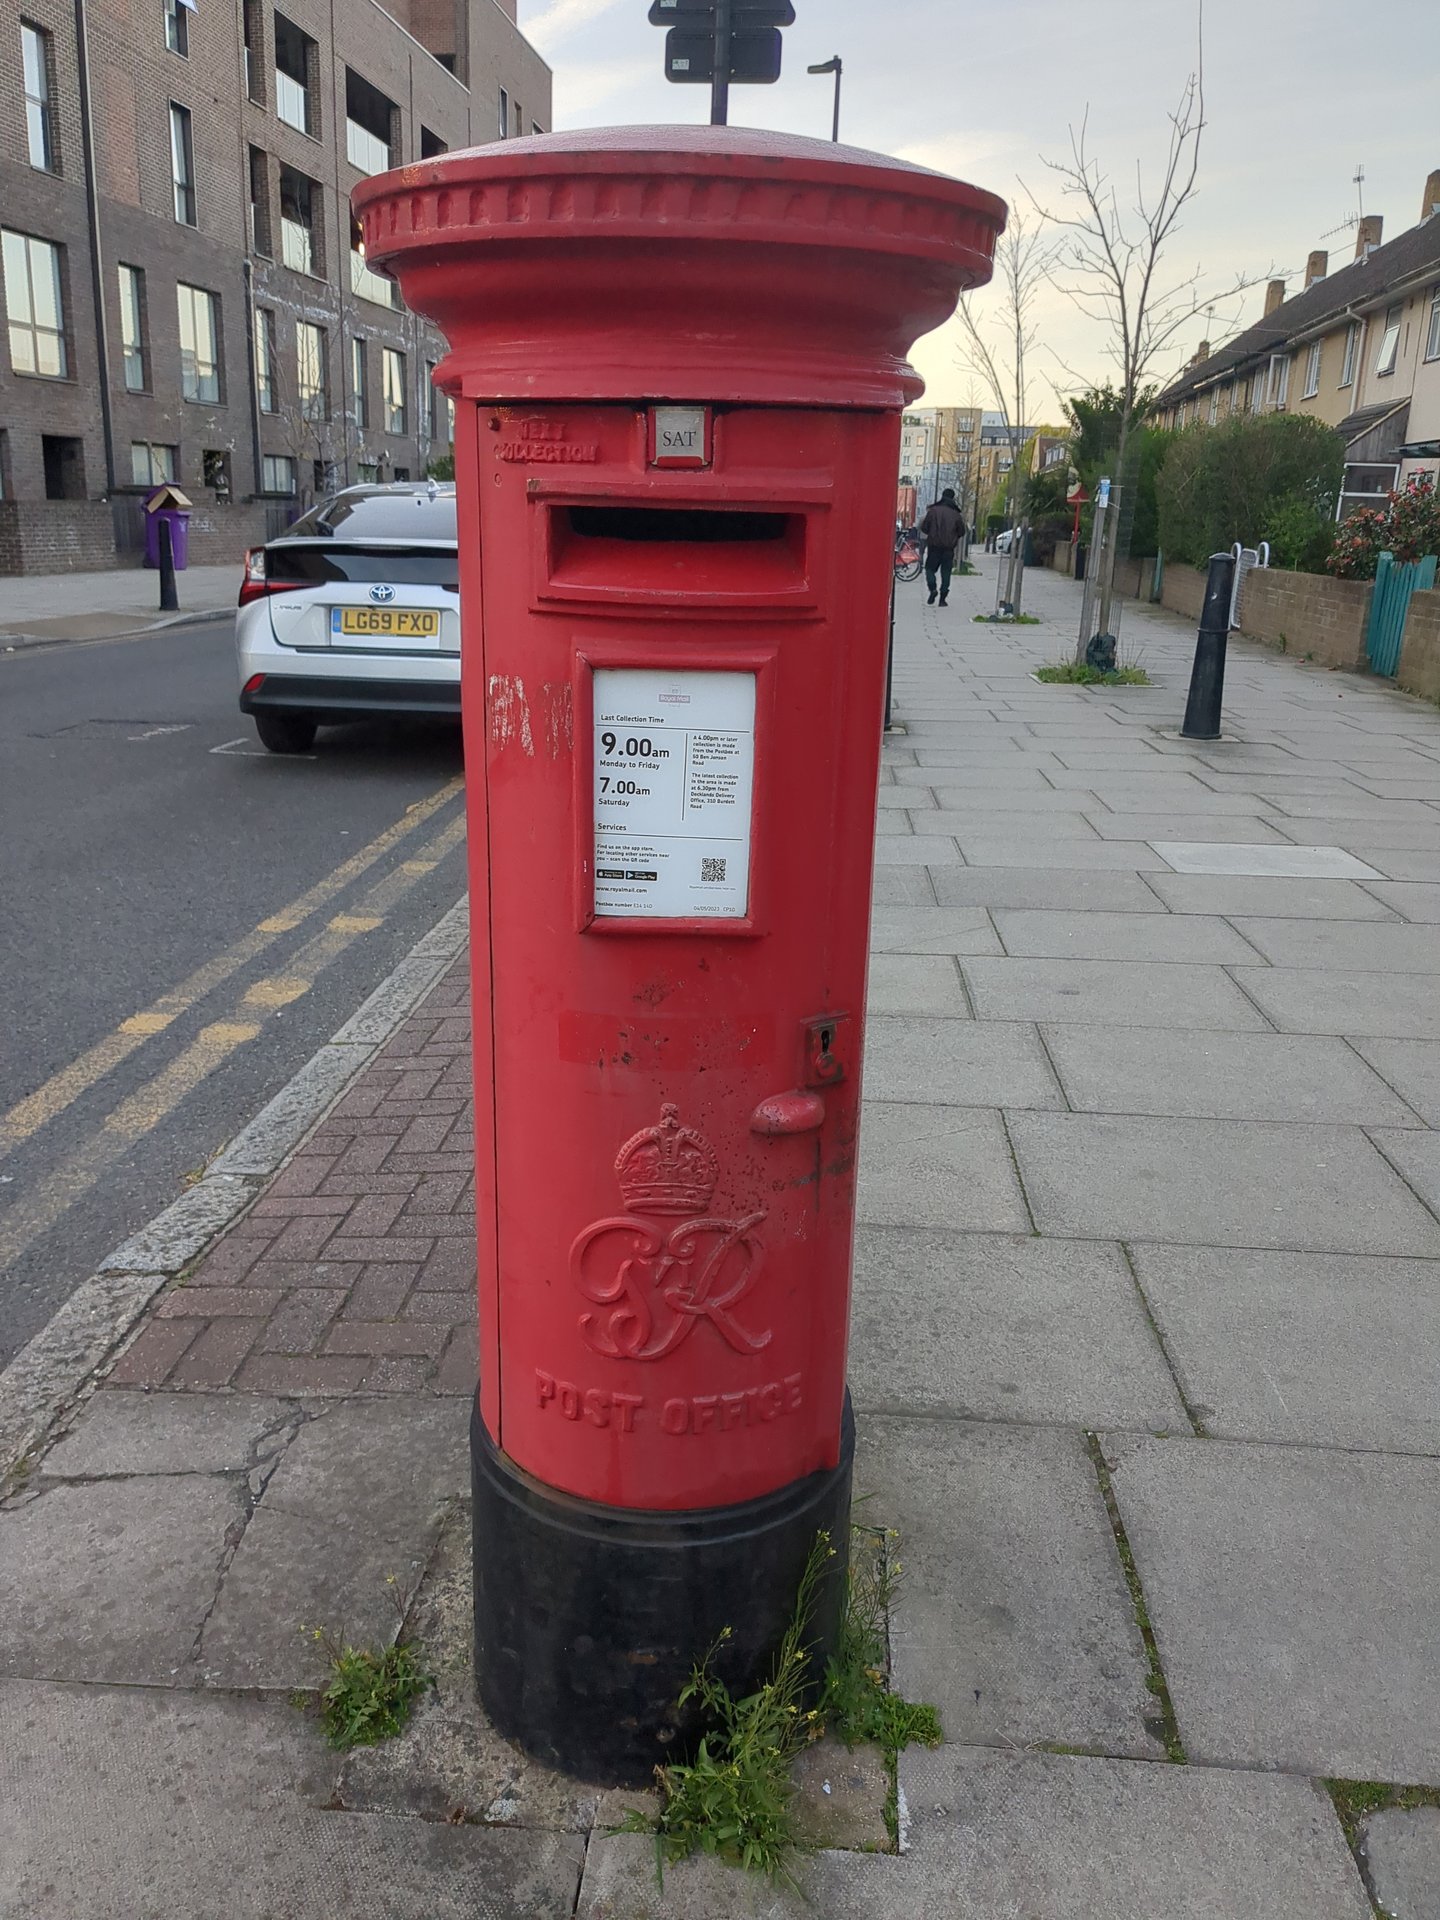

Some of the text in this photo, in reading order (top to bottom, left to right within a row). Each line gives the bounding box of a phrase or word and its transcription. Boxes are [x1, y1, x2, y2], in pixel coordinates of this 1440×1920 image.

[662, 431, 697, 448] SAT
[343, 611, 434, 632] LG69 FXO
[616, 715, 647, 723] Collection
[601, 732, 670, 758] 9.00am
[600, 760, 626, 769] Monday
[638, 762, 660, 771] Friday
[599, 777, 651, 795] 7.00am
[598, 798, 630, 807] Saturday
[597, 823, 627, 831] Services
[535, 1367, 643, 1433] POST
[660, 1371, 803, 1435] OFFICE
